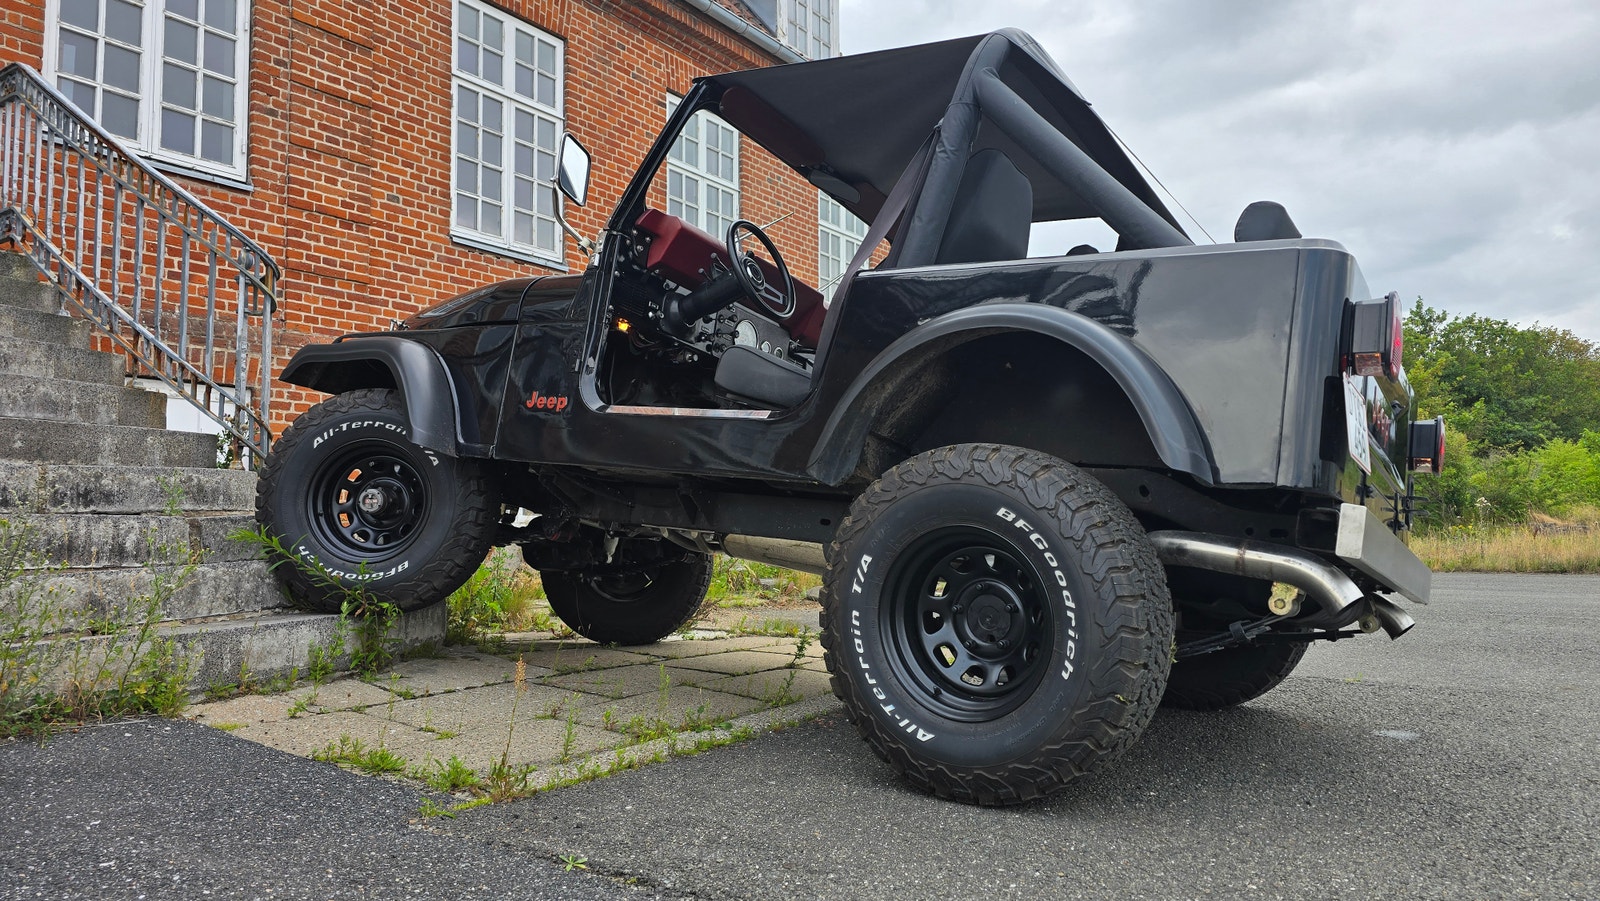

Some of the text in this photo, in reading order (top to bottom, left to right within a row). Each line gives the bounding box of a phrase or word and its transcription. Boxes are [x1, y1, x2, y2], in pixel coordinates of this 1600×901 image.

[525, 390, 568, 412] Jeep
[849, 552, 937, 743] All-Terrain T/A
[995, 506, 1080, 681] BFGoodrich
